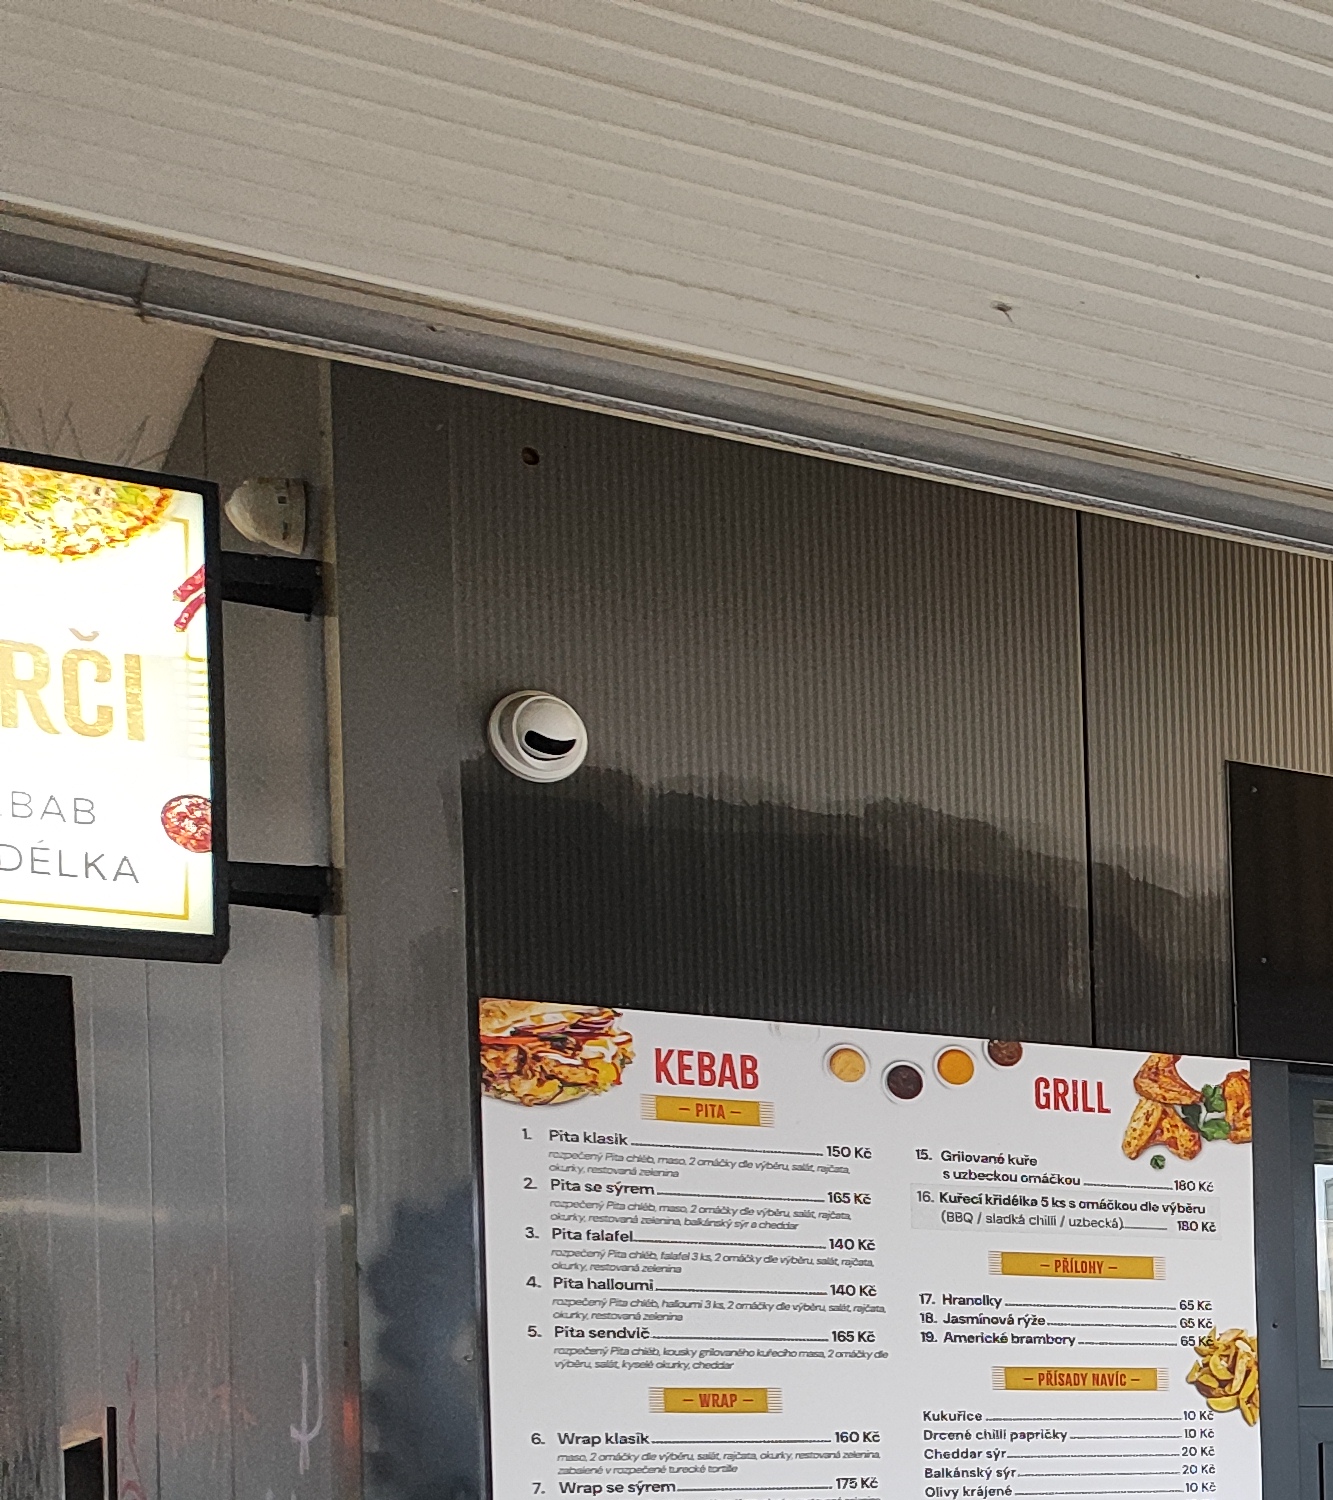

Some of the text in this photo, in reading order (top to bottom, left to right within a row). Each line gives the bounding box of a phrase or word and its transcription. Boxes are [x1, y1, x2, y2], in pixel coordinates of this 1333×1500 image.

[0, 791, 96, 825] BAB
[655, 1048, 758, 1089] KEBAB
[1035, 1077, 1111, 1113] GRILL
[696, 1102, 725, 1119] PITA
[549, 1130, 851, 1157] Pita klasik 150
[941, 1150, 1037, 1166] Grilované kuře
[551, 1179, 850, 1203] Pita se sýrem 165
[1174, 1180, 1195, 1191] 180
[1041, 1197, 1049, 1207] 5
[1052, 1197, 1066, 1208] ks
[1140, 1201, 1159, 1212] dle
[941, 1210, 973, 1224] (BBQ
[1177, 1221, 1198, 1231] 180
[552, 1228, 854, 1250] Pita falafel 140
[1055, 1257, 1104, 1277] PŘÍLOHY
[554, 1277, 855, 1296] Pita halloumi 140
[943, 1294, 1194, 1310] Hranolky 65
[943, 1313, 1195, 1328] Jasmínová rýže 65
[555, 1326, 854, 1342] Pita sendvič 165
[944, 1332, 1195, 1346] Americké brambory 65
[1039, 1368, 1126, 1386] PŘÍSADY NAVÍC
[699, 1393, 737, 1409] WRAP
[923, 1411, 982, 1421] Kukuřice
[557, 1432, 859, 1447] Wrap klasik 160
[924, 1429, 972, 1440] Drcené
[1010, 1429, 1067, 1442] papričky
[924, 1448, 1006, 1461] Cheddar sýr
[925, 1467, 1016, 1480] Balkánský sýr
[559, 1478, 857, 1496] Wrap se sýrem 175
[925, 1485, 1012, 1499] Olivy krájené
